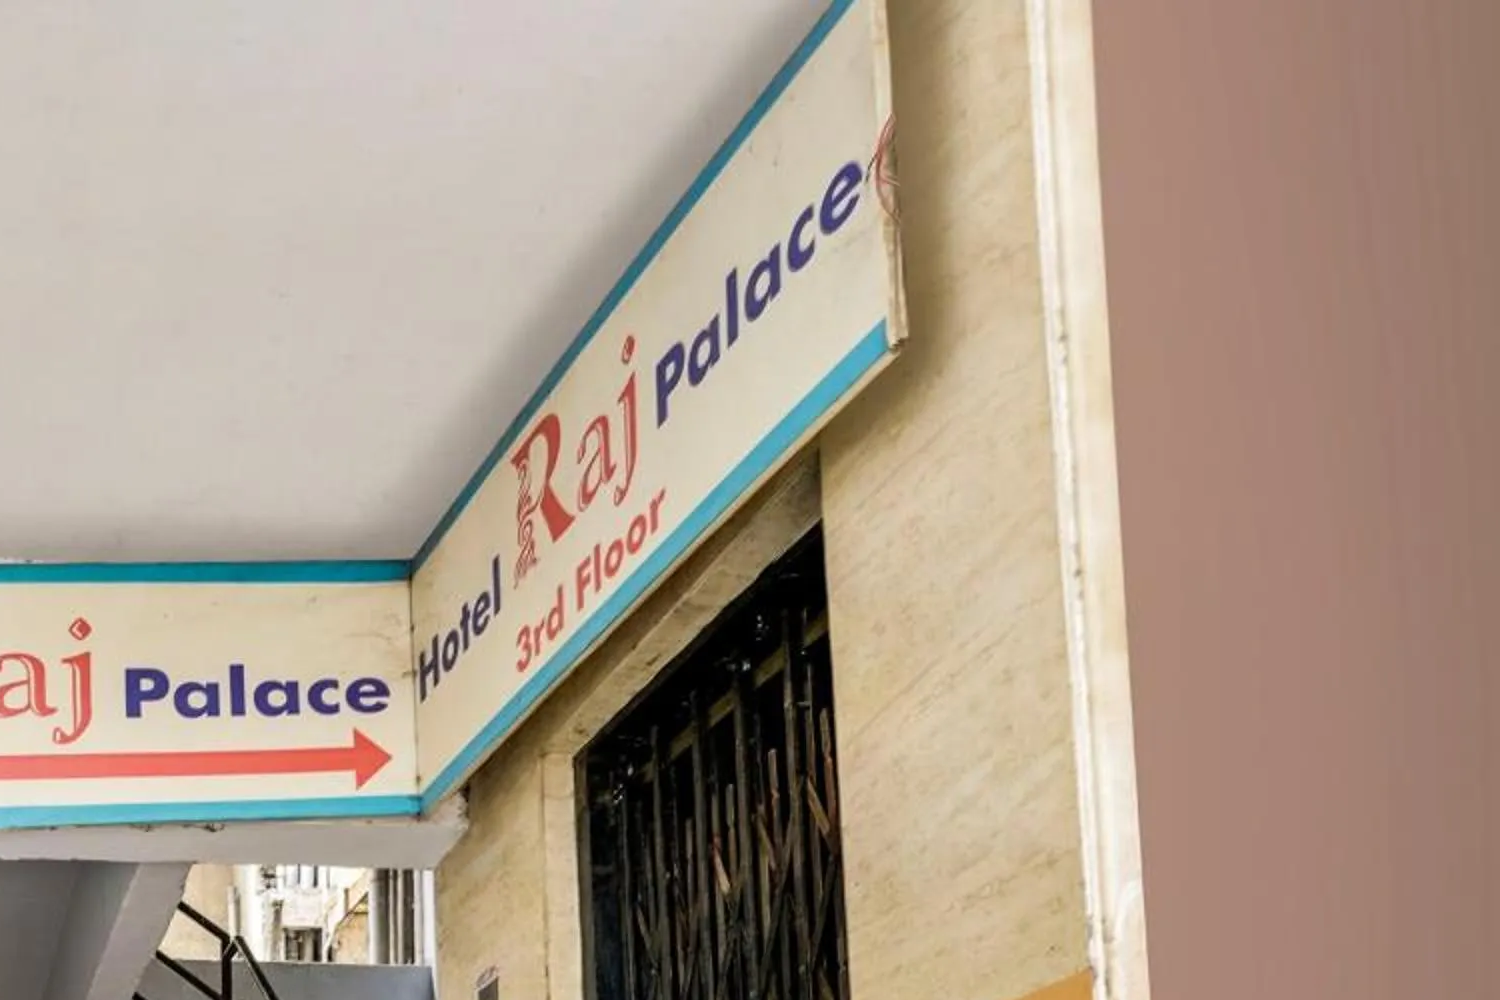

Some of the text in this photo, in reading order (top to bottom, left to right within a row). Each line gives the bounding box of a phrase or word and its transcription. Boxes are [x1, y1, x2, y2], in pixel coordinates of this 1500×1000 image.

[418, 160, 864, 703] Hotel Raj Palace
[515, 487, 666, 673] 3rd Floor
[124, 663, 391, 719] Palace
